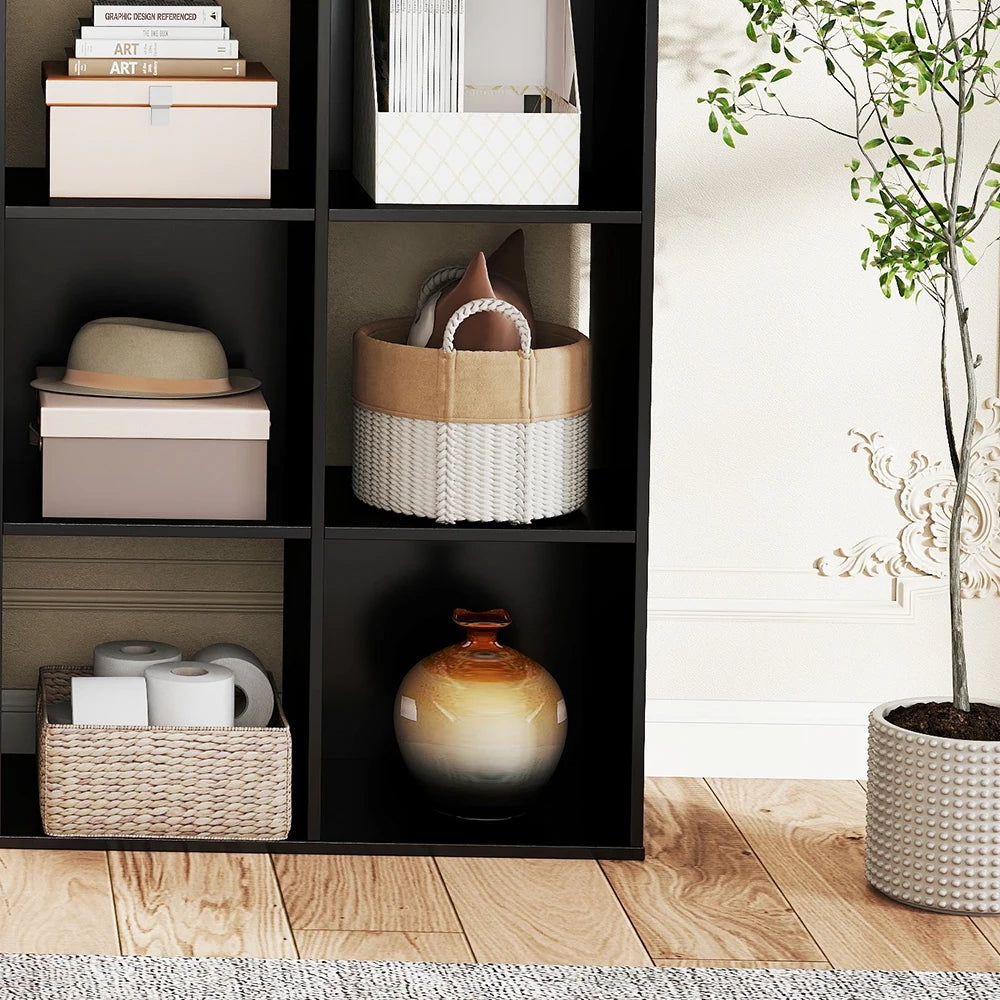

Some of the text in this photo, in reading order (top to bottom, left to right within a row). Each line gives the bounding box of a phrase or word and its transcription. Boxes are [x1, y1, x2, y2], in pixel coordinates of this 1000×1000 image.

[104, 12, 132, 21] GRAPHIC
[133, 12, 156, 21] DESIGN
[156, 12, 197, 21] REFERENCED
[113, 42, 140, 56] ART
[109, 61, 138, 75] ART
